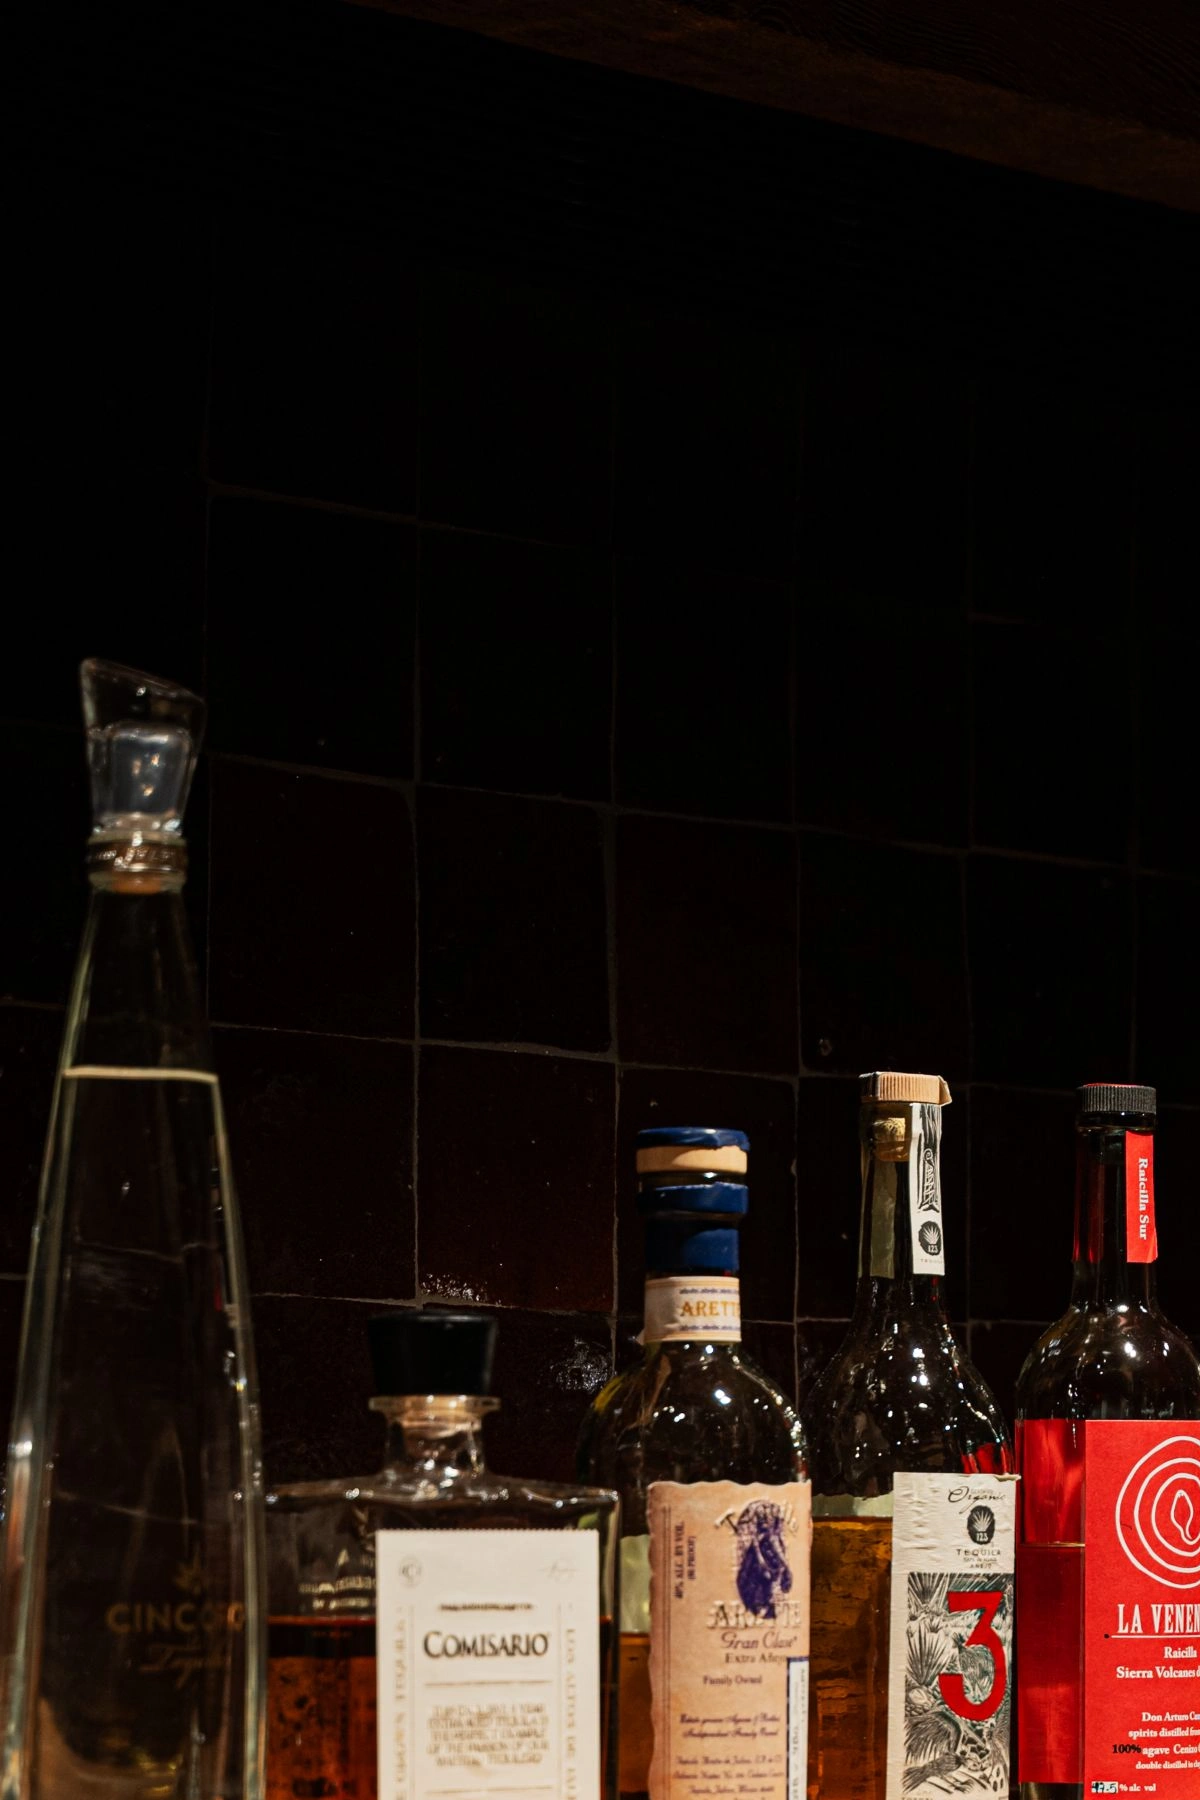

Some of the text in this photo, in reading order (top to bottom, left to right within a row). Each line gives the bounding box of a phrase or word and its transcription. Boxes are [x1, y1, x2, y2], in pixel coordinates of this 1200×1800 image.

[1138, 1158, 1150, 1240] Raicilla Sur
[1117, 1604, 1143, 1634] LA
[938, 1590, 1005, 1722] 3
[1164, 1646, 1198, 1659] Raicilla
[1116, 1666, 1153, 1679] Sierra
[1141, 1712, 1162, 1723] Don
[1128, 1728, 1158, 1740] spirits
[1112, 1743, 1142, 1755] 100%
[1142, 1746, 1170, 1758] agave
[1135, 1760, 1161, 1770] double
[1144, 1783, 1157, 1793] vol
